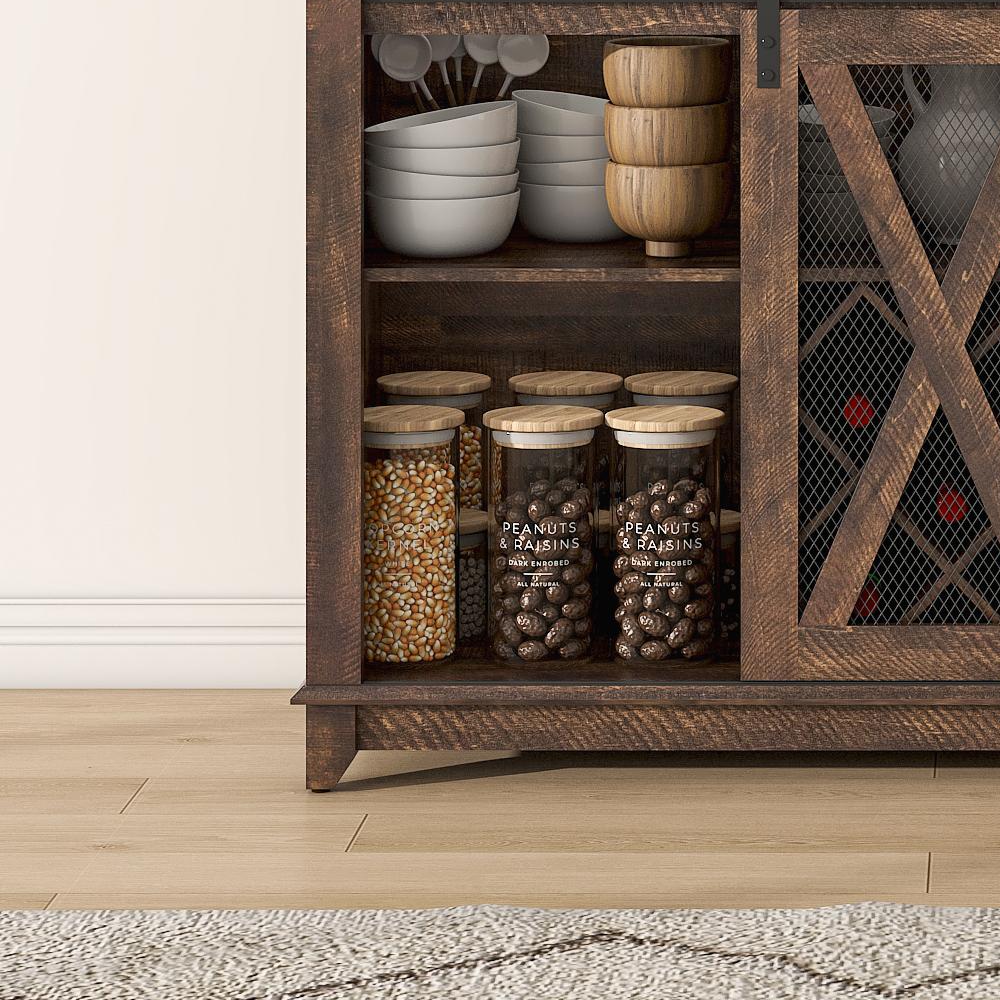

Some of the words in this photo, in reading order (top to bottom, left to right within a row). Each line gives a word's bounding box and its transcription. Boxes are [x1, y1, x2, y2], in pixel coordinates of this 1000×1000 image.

[364, 522, 441, 536] OPCORN
[503, 521, 577, 535] PEANUTS
[626, 521, 700, 535] PEANUTS
[499, 537, 508, 550] &
[514, 537, 580, 551] RAISINS
[622, 537, 631, 550] &
[637, 537, 703, 551] RAISINS
[508, 559, 529, 567] DARK
[531, 559, 570, 567] ENROBED
[631, 559, 652, 567] DARK
[654, 559, 693, 567] ENROBED
